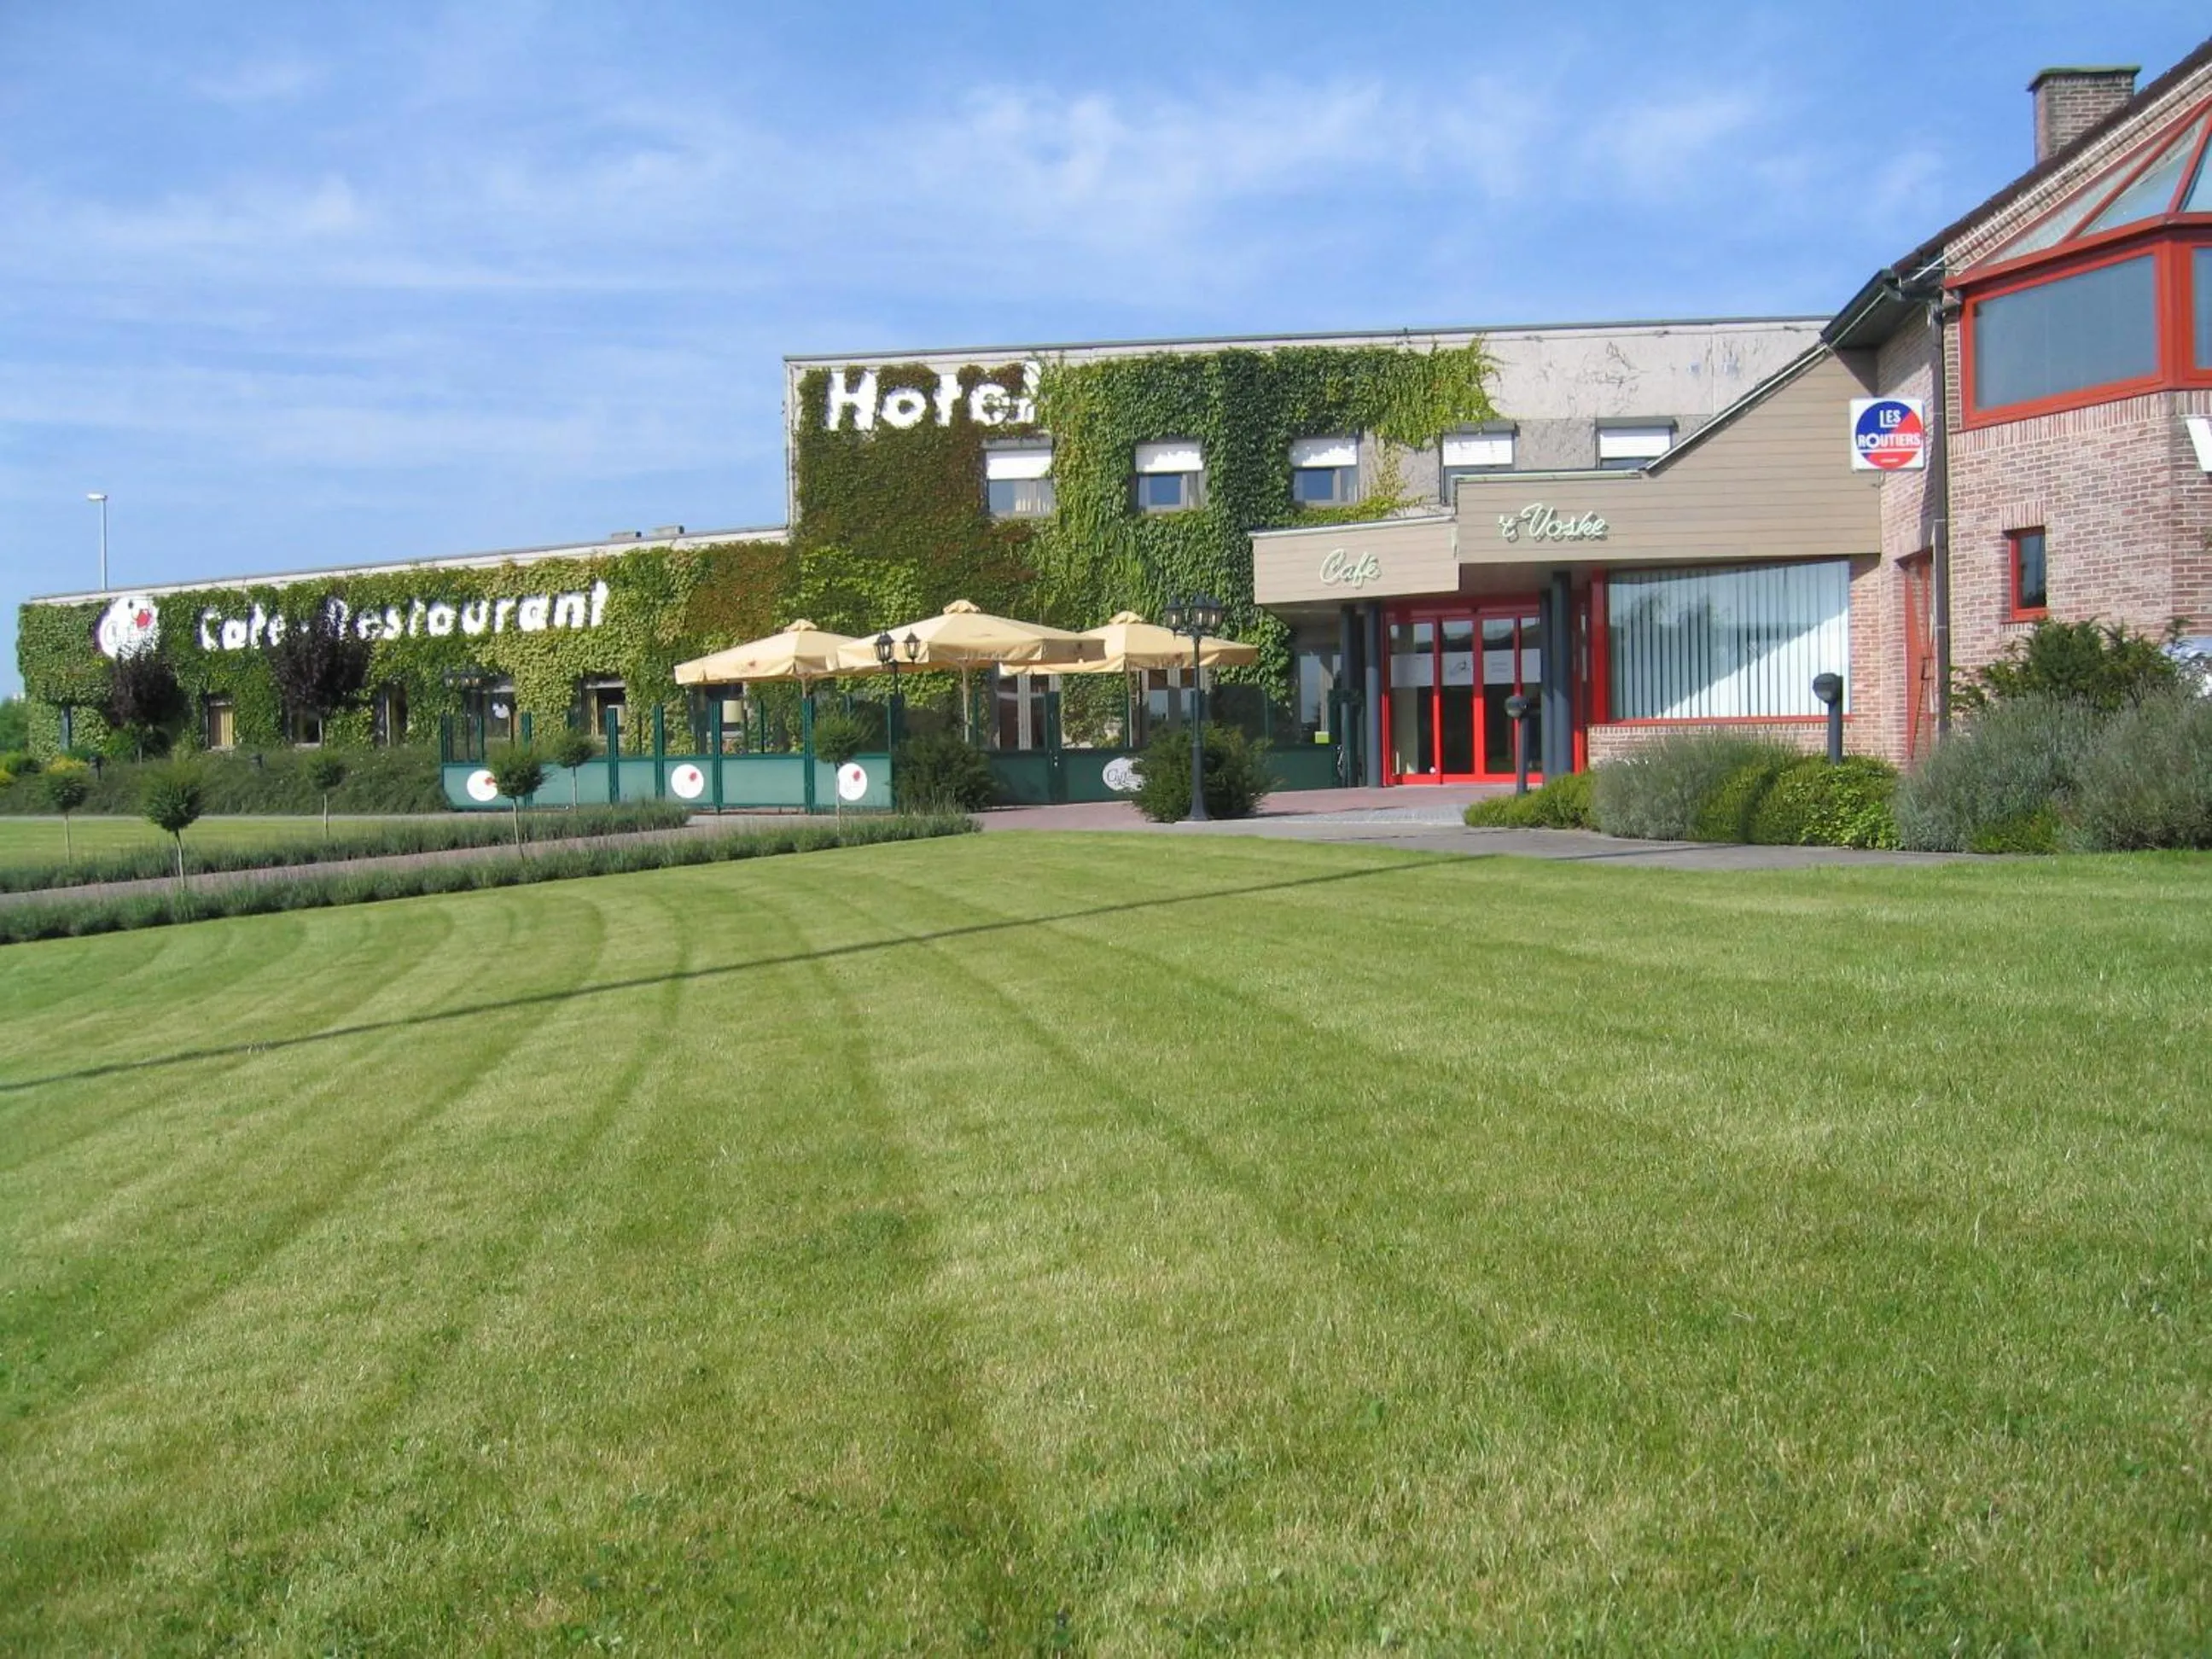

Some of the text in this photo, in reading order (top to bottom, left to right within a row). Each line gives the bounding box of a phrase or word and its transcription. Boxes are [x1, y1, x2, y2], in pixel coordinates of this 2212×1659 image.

[1879, 410, 1901, 428] LES
[1857, 433, 1921, 449] ROUTIERS
[1520, 502, 1609, 541] Voske
[1319, 548, 1382, 590] Café
